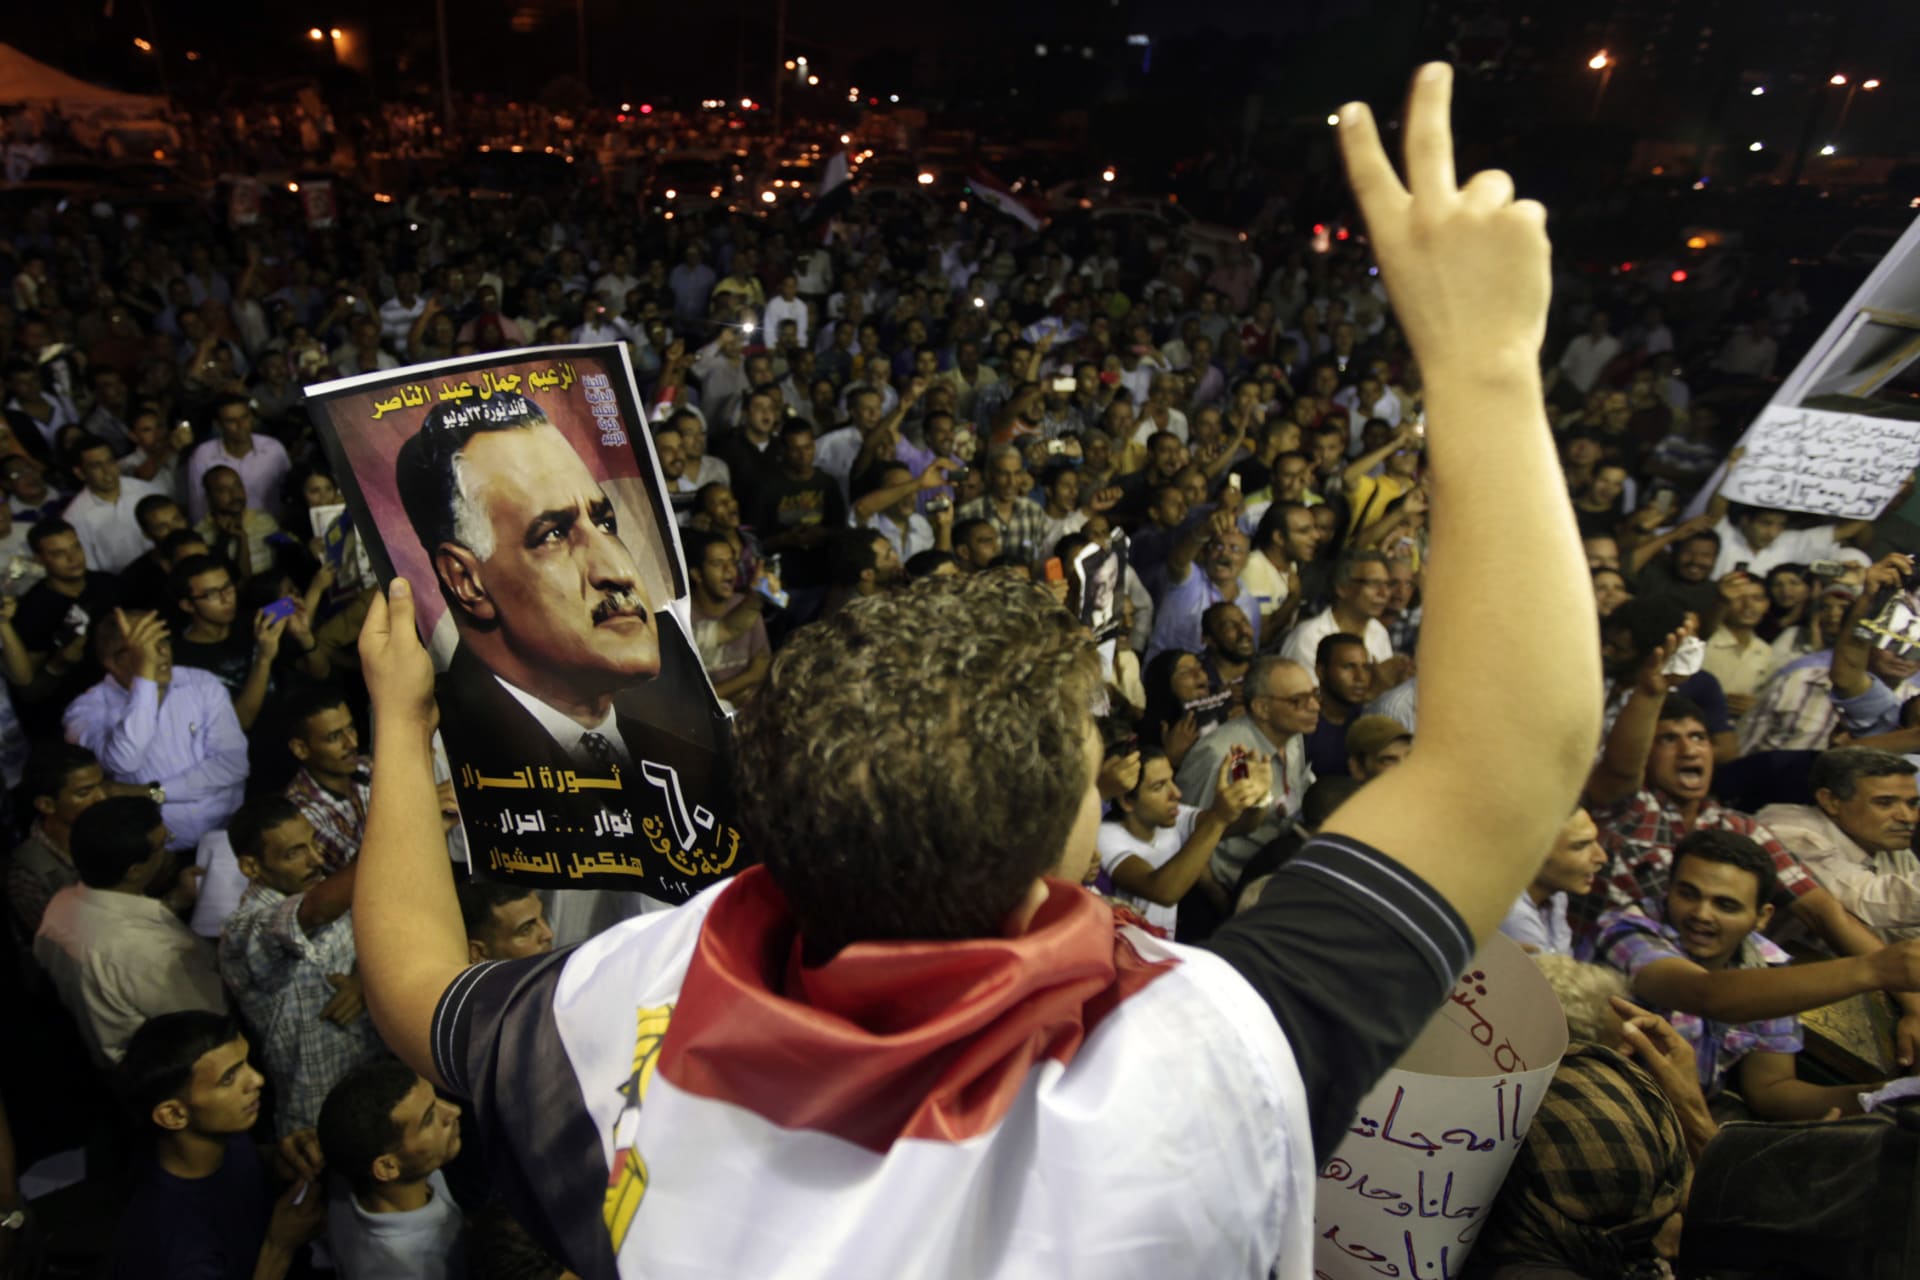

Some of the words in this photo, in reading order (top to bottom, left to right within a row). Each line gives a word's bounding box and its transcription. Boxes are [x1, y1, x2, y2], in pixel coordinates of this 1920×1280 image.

[478, 371, 522, 401] جمال
[528, 361, 578, 393] الزعيم
[371, 384, 432, 420] الناصر
[438, 380, 474, 405] عبد
[481, 401, 507, 422] ثورة
[508, 398, 528, 416] قائد
[461, 763, 535, 790] احرار
[539, 764, 623, 793] ثورة
[594, 808, 634, 837] ثوار
[489, 847, 561, 873] المشوار
[568, 852, 644, 878] هنكمل
